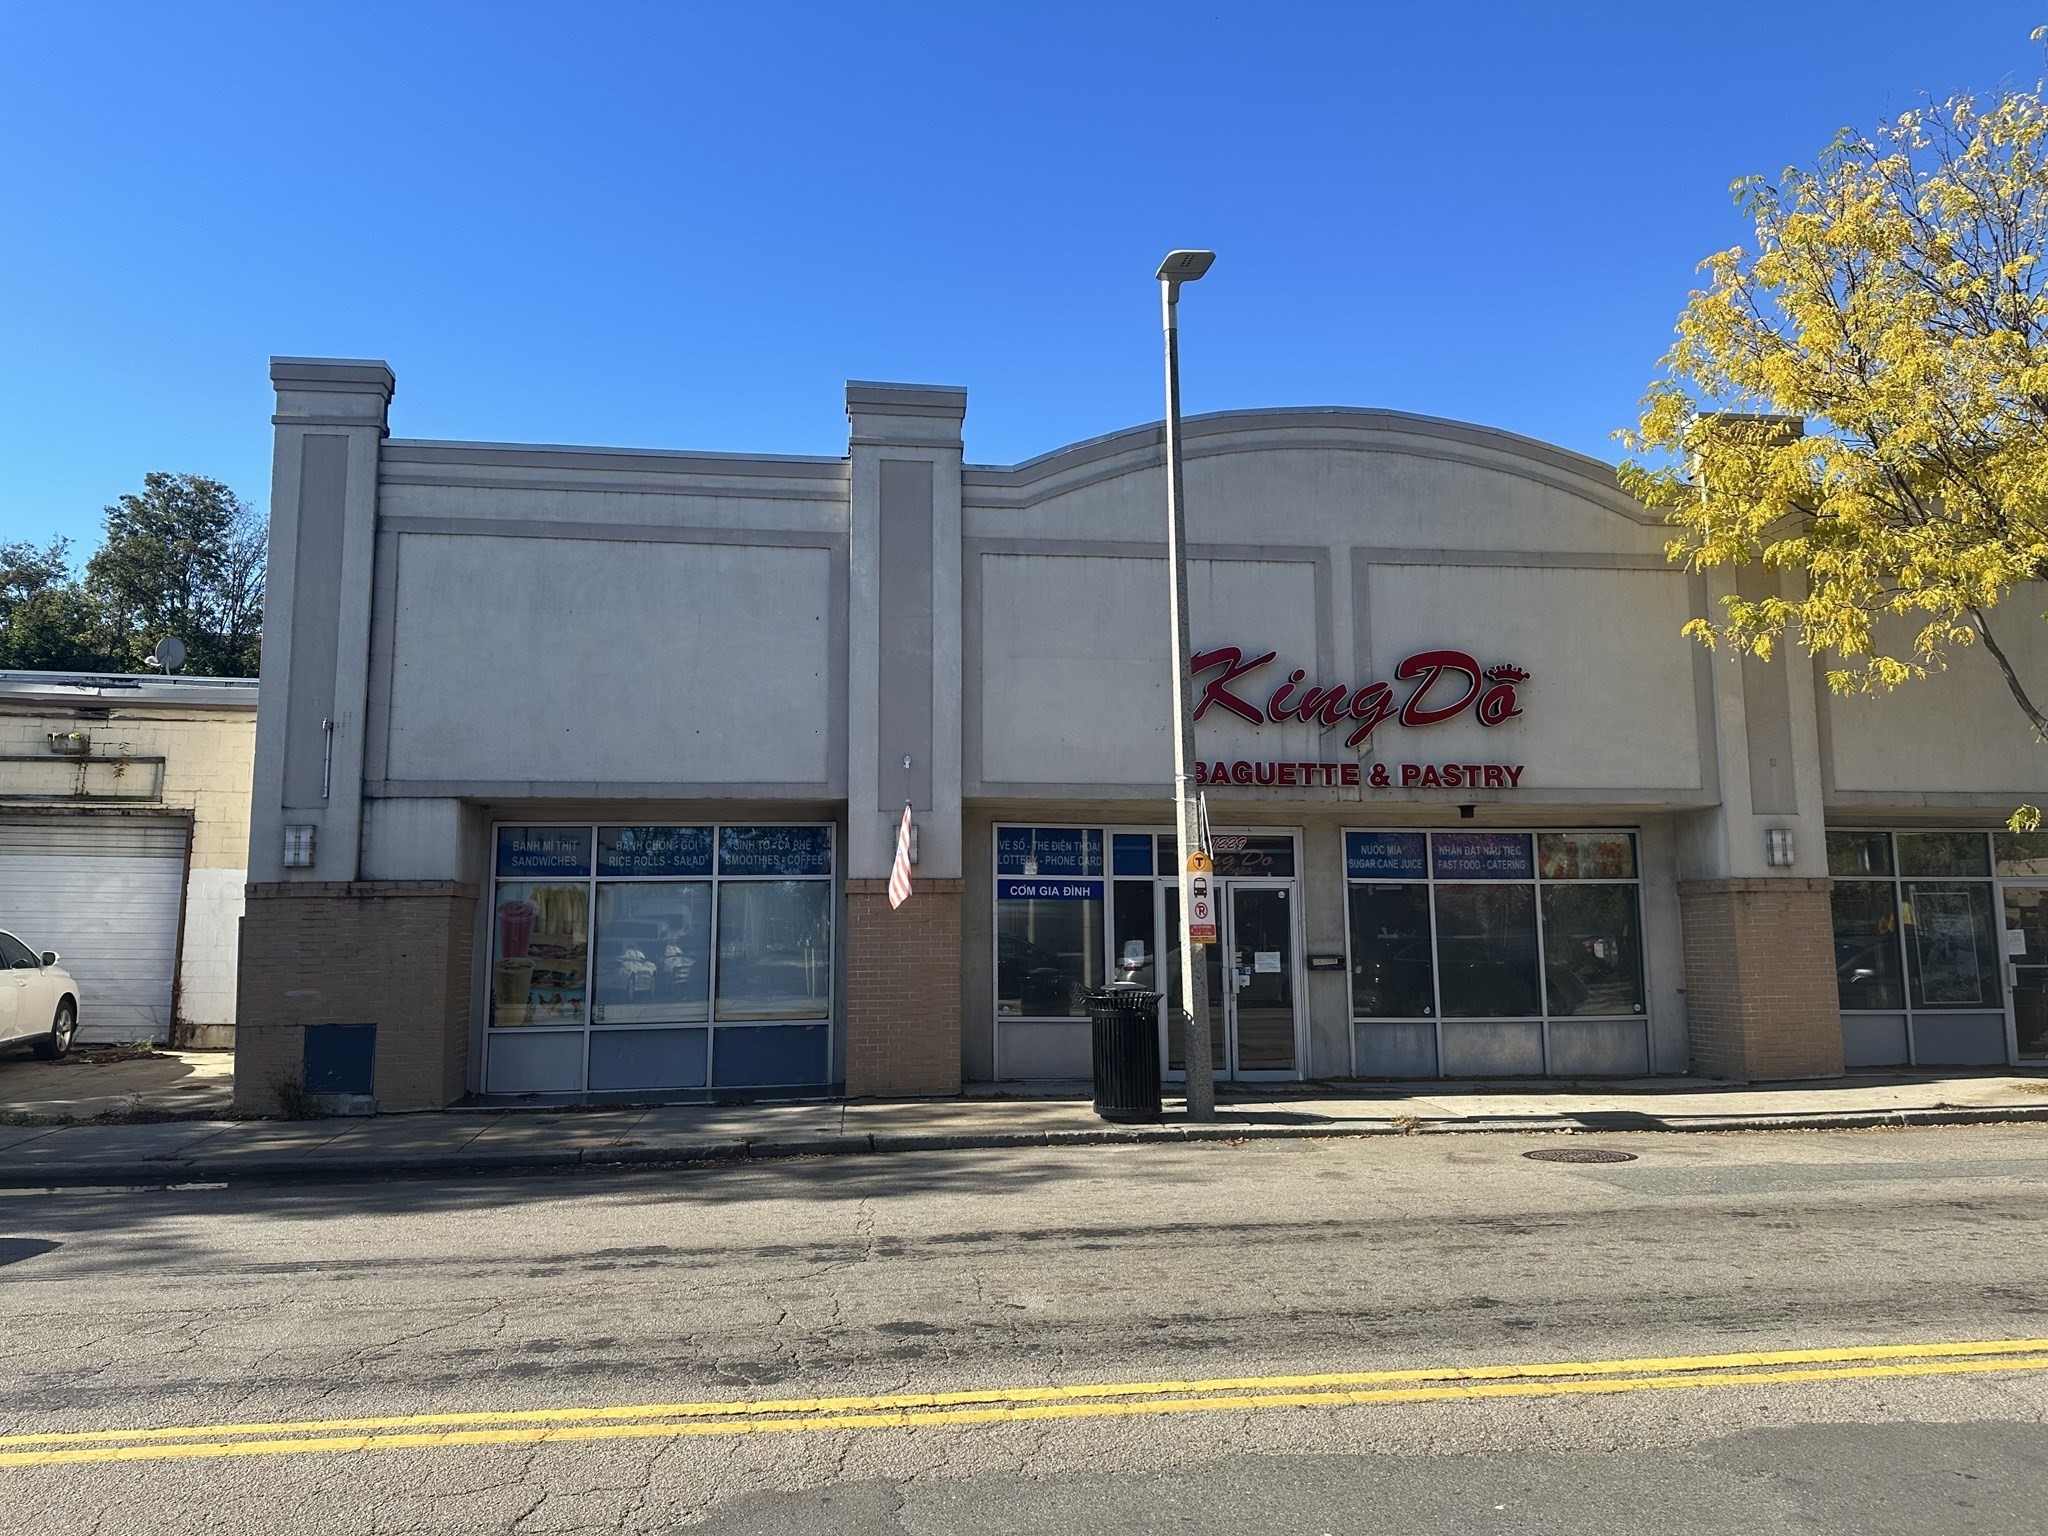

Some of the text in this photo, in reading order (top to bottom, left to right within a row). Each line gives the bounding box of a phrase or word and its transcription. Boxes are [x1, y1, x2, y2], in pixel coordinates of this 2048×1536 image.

[1195, 762, 1524, 788] BAGUETTE & PASTRY
[1212, 836, 1247, 850] 1229
[512, 856, 577, 866] SANDWICHES
[609, 856, 631, 866] RICE
[634, 856, 665, 866] ROLLS
[674, 856, 705, 866] SALAD
[725, 855, 779, 865] SMOOTHIES
[788, 855, 823, 865] COFFEE
[1045, 856, 1075, 865] PHONE
[1078, 856, 1102, 865] CARD
[1349, 859, 1422, 868] SUGAR CANE JUICE
[1438, 860, 1457, 869] FAST
[1459, 860, 1480, 869] FOOD
[1487, 860, 1525, 870] CATERING
[1039, 886, 1059, 896] GIA
[1063, 885, 1090, 896] ĐÌNH
